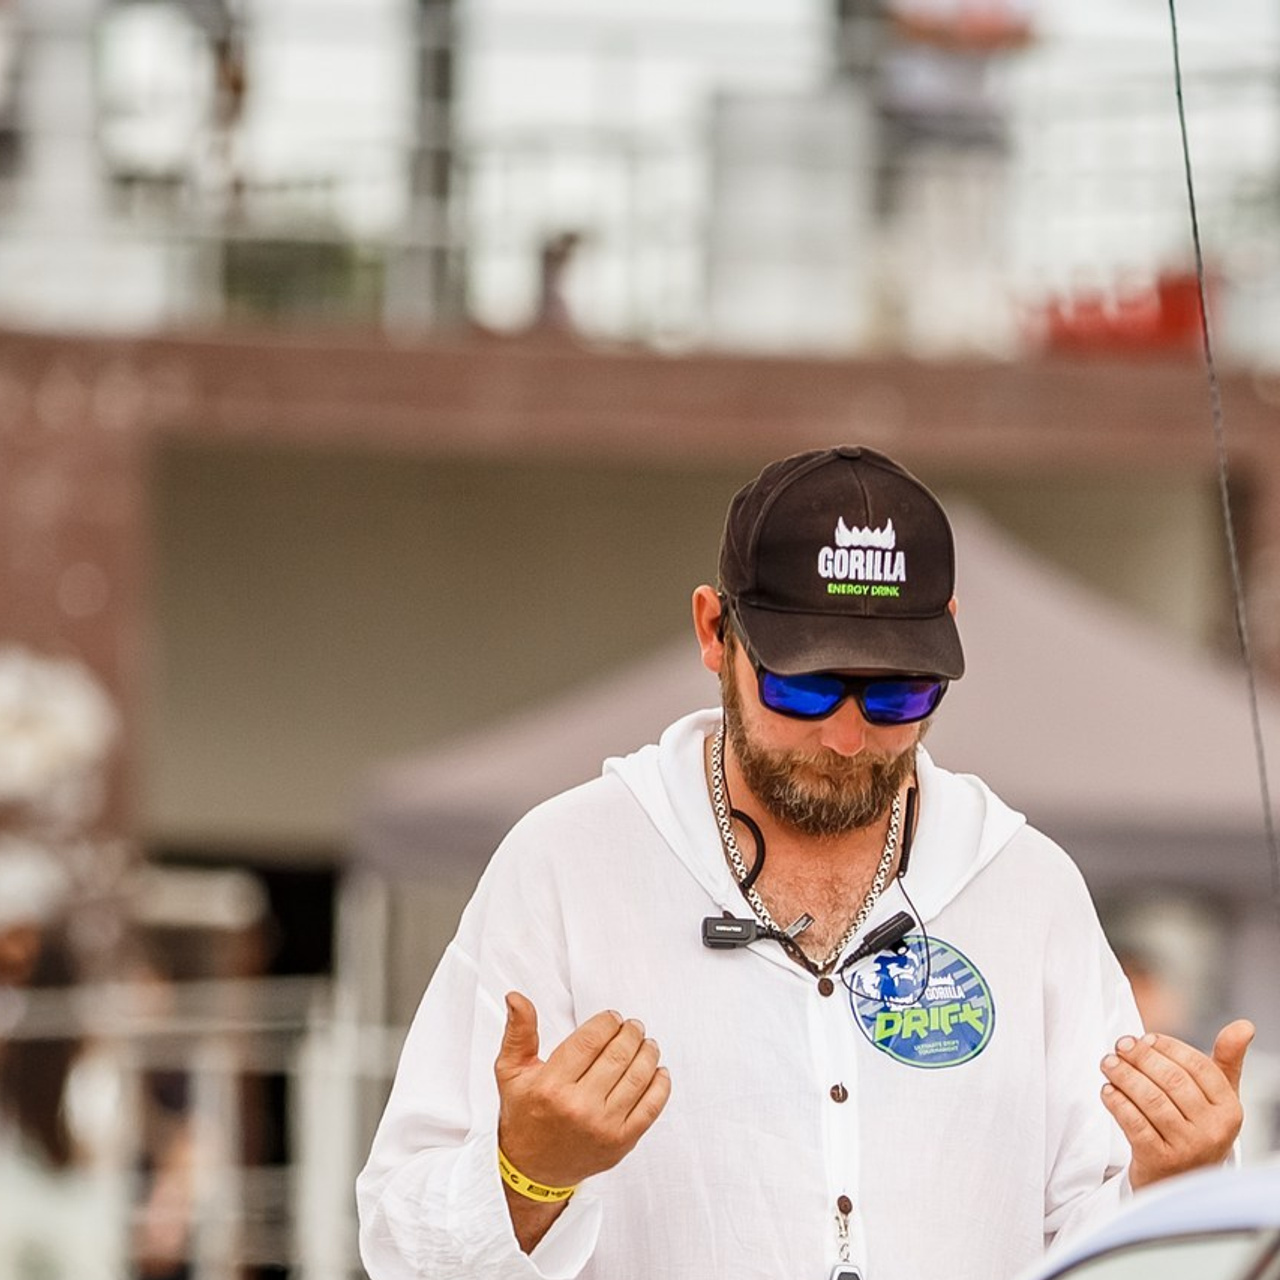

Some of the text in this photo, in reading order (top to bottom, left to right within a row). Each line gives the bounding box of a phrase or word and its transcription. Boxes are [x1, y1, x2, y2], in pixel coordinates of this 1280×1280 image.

[817, 546, 906, 582] GORILLA
[827, 583, 900, 597] ENERGY DRINK
[925, 985, 966, 1001] GORILLA
[873, 1002, 986, 1043] DRIFT
